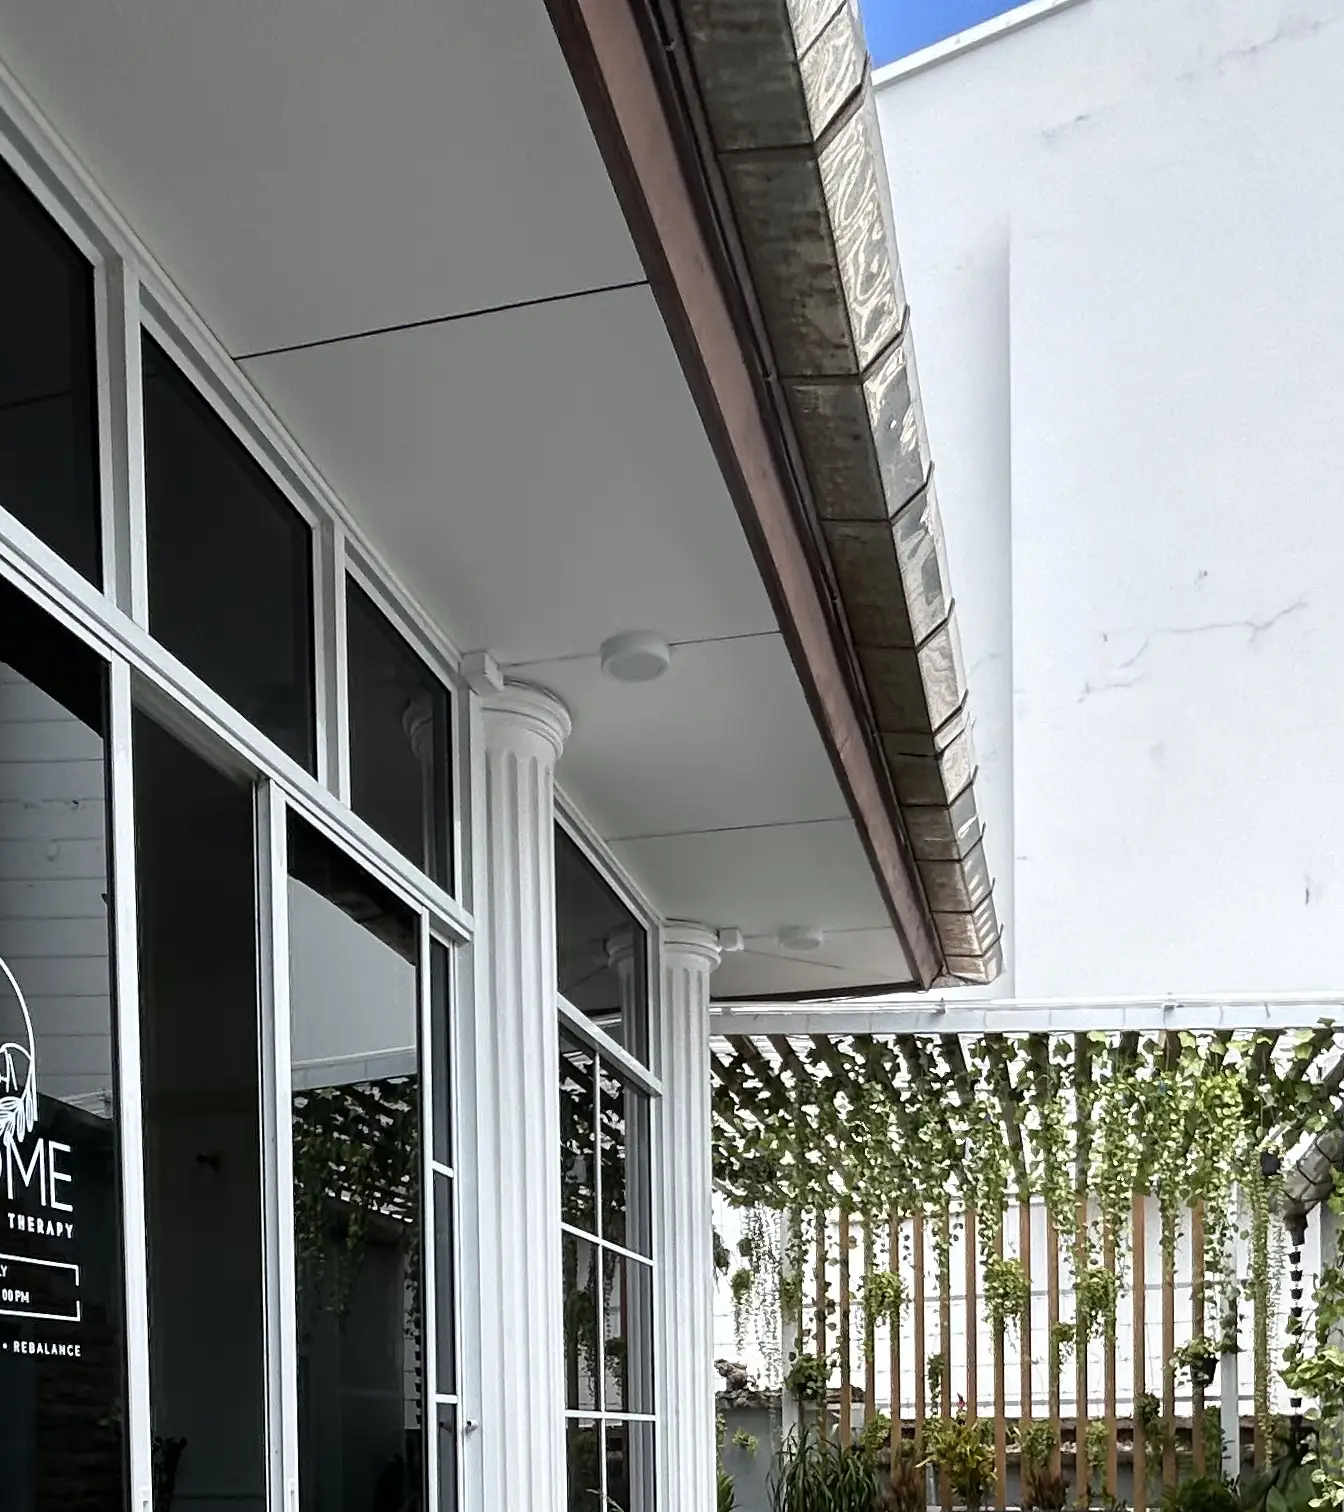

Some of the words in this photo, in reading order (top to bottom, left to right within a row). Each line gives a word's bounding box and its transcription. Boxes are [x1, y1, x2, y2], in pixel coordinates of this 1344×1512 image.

[7, 1212, 74, 1239] THERAPY
[14, 1289, 30, 1304] PM
[13, 1341, 81, 1357] REBALANCE
